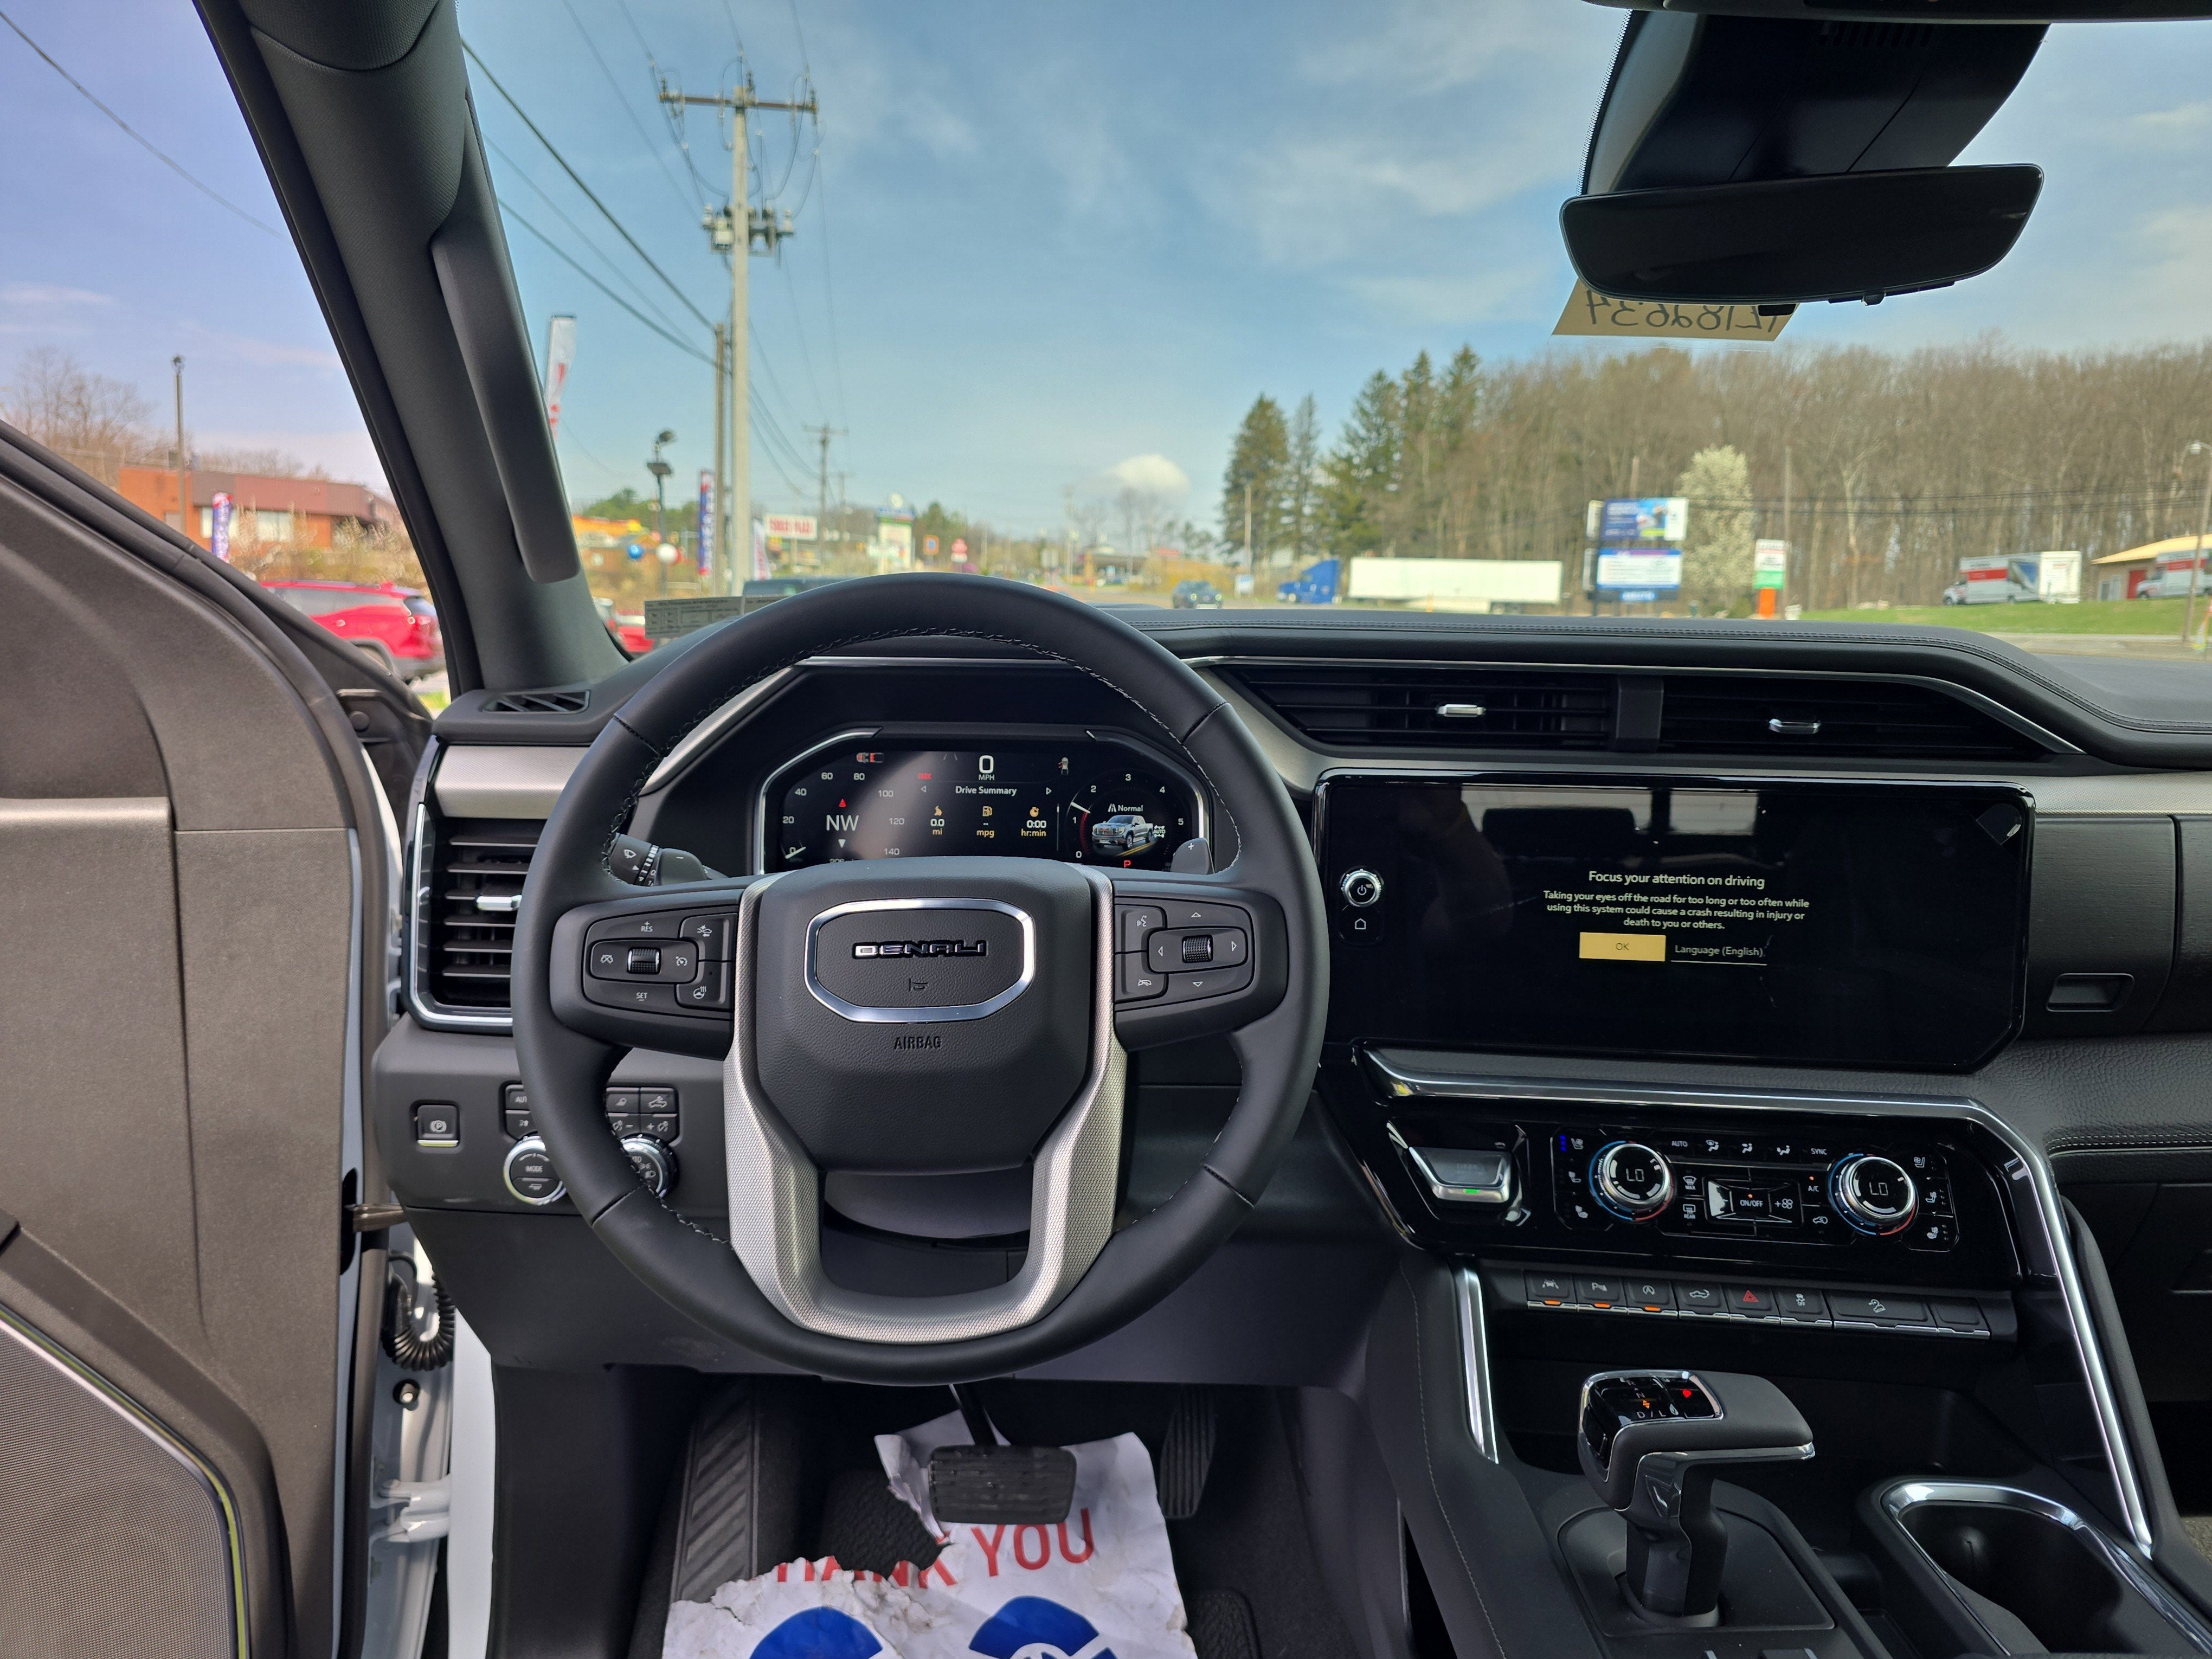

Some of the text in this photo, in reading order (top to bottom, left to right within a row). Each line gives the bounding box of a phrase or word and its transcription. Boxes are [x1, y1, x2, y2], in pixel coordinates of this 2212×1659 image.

[979, 755, 994, 774] 0
[853, 773, 865, 781] 80
[795, 788, 807, 796] 40
[955, 786, 1017, 797] Drive Summary
[826, 815, 859, 831] NW
[1026, 820, 1046, 828] 0:00
[976, 829, 994, 838] mpg
[1589, 871, 1765, 890] Focus your attention on driving
[1544, 890, 1572, 902] Taking
[1573, 893, 1595, 902] your
[1596, 894, 1617, 903] eyes
[1618, 893, 1632, 901] off
[1633, 893, 1649, 902] the
[1650, 895, 1671, 903] road
[1673, 895, 1686, 903] for
[1688, 896, 1704, 904] too
[1705, 896, 1726, 907] long
[1758, 897, 1783, 906] often
[1784, 898, 1810, 908] while
[1547, 904, 1572, 914] using
[1573, 904, 1590, 912] this
[1592, 905, 1624, 915] system
[1625, 906, 1650, 915] could
[1687, 908, 1712, 916] crash
[1713, 909, 1754, 920] resulting
[1756, 910, 1765, 918] in
[1766, 911, 1793, 921] injury
[1623, 917, 1650, 926] death
[1662, 921, 1680, 929] you
[1692, 920, 1725, 929] others.
[854, 941, 987, 958] DENALI
[1616, 942, 1629, 950] OK
[1675, 945, 1764, 958] Language (English)
[893, 1036, 942, 1050] AIRBAG
[1626, 1168, 1644, 1182] LO
[1869, 1182, 1888, 1196] LO
[971, 1508, 1095, 1577] YOU
